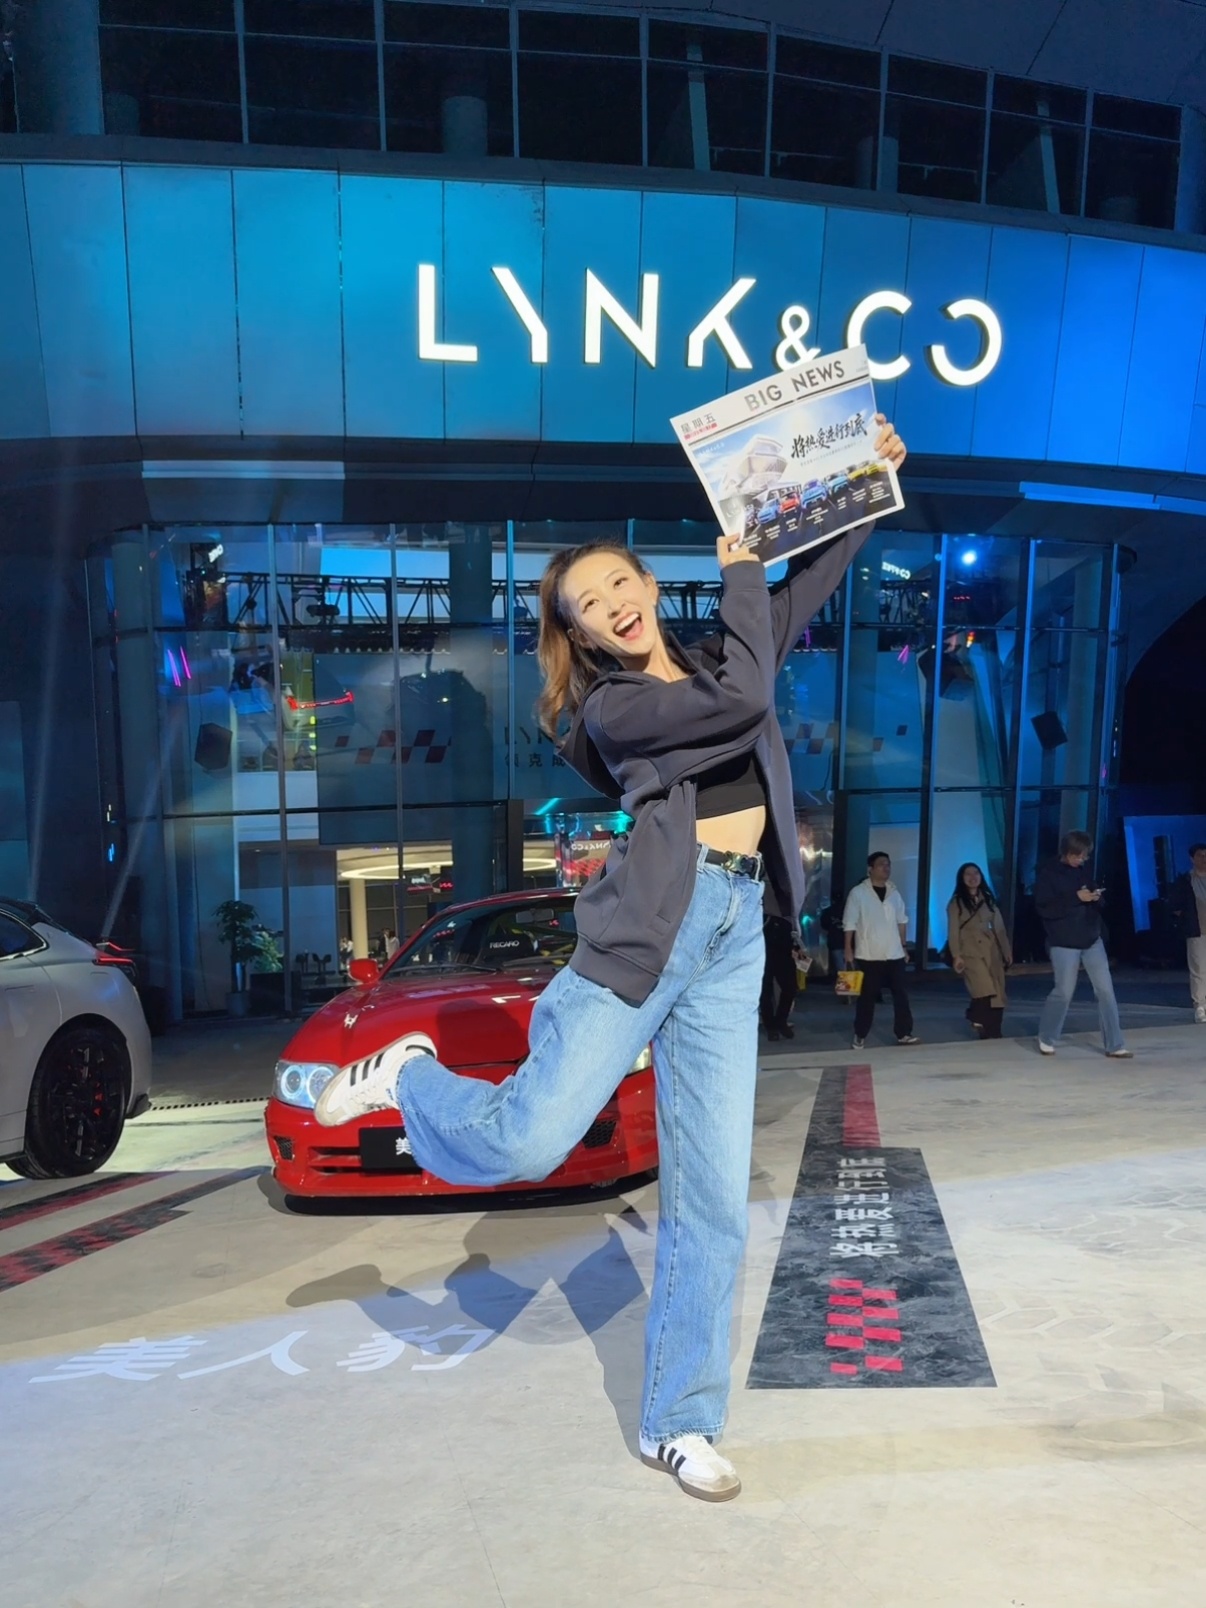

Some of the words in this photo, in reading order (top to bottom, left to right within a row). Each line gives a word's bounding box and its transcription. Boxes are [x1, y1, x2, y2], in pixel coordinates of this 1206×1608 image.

[744, 384, 783, 412] BIG
[791, 360, 845, 393] NEWS
[681, 412, 716, 434] 星期五
[790, 413, 868, 459] 将热爱进行到底
[489, 940, 520, 949] RECARO
[829, 1157, 900, 1259] 将热爱进行到底
[28, 1322, 498, 1383] 美人豹
